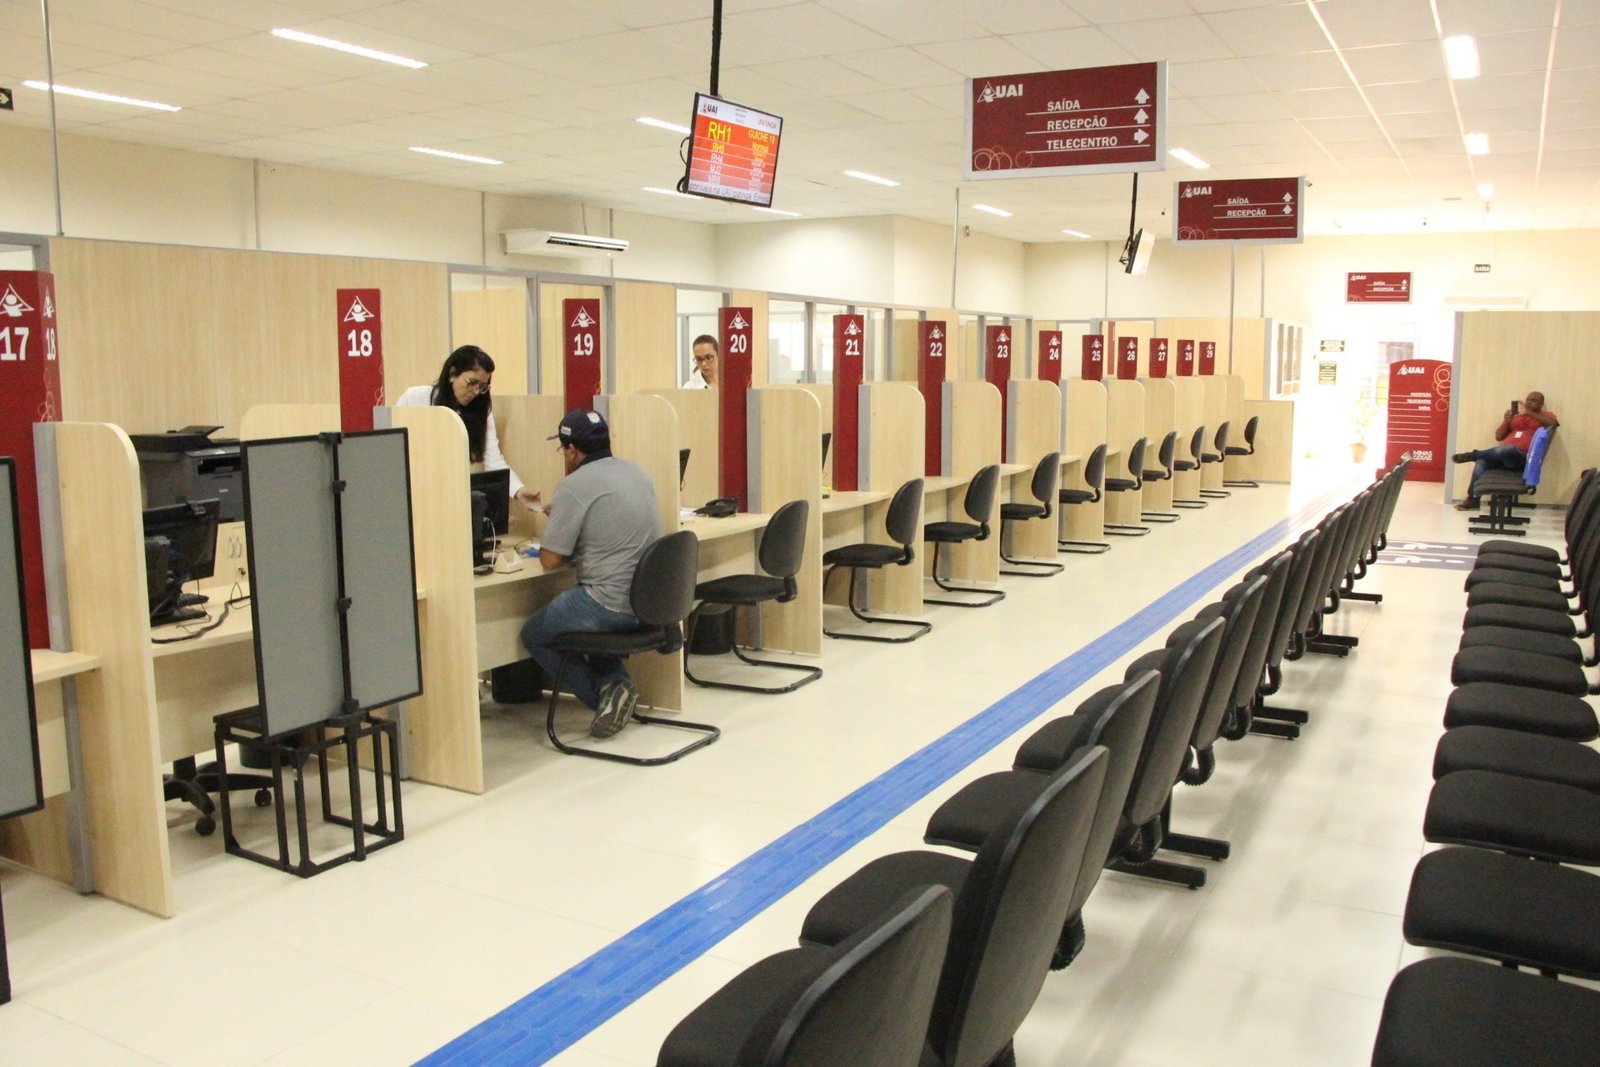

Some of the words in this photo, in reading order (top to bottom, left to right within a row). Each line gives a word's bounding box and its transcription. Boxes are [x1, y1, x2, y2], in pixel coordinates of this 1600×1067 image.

[995, 84, 1024, 98] UAI
[708, 104, 718, 114] UAI
[1047, 98, 1080, 112] SAÍDA
[1047, 116, 1107, 131] RECEPÇÃO
[708, 120, 732, 144] RH1
[1047, 136, 1118, 150] TELECENTRO
[1193, 186, 1212, 196] UAI
[1227, 196, 1249, 205] SAÍDA
[1227, 208, 1266, 217] RECEPÇÃO
[0, 326, 30, 361] 17
[46, 328, 56, 361] 18
[348, 329, 373, 357] 18
[574, 333, 594, 356] 19
[730, 334, 747, 353] 20
[845, 339, 860, 356] 21
[930, 342, 942, 357] 22
[997, 345, 1008, 358] 23
[1049, 348, 1059, 360] 24
[1092, 350, 1101, 362] 25
[1127, 351, 1136, 361] 26
[1158, 352, 1166, 361] 27
